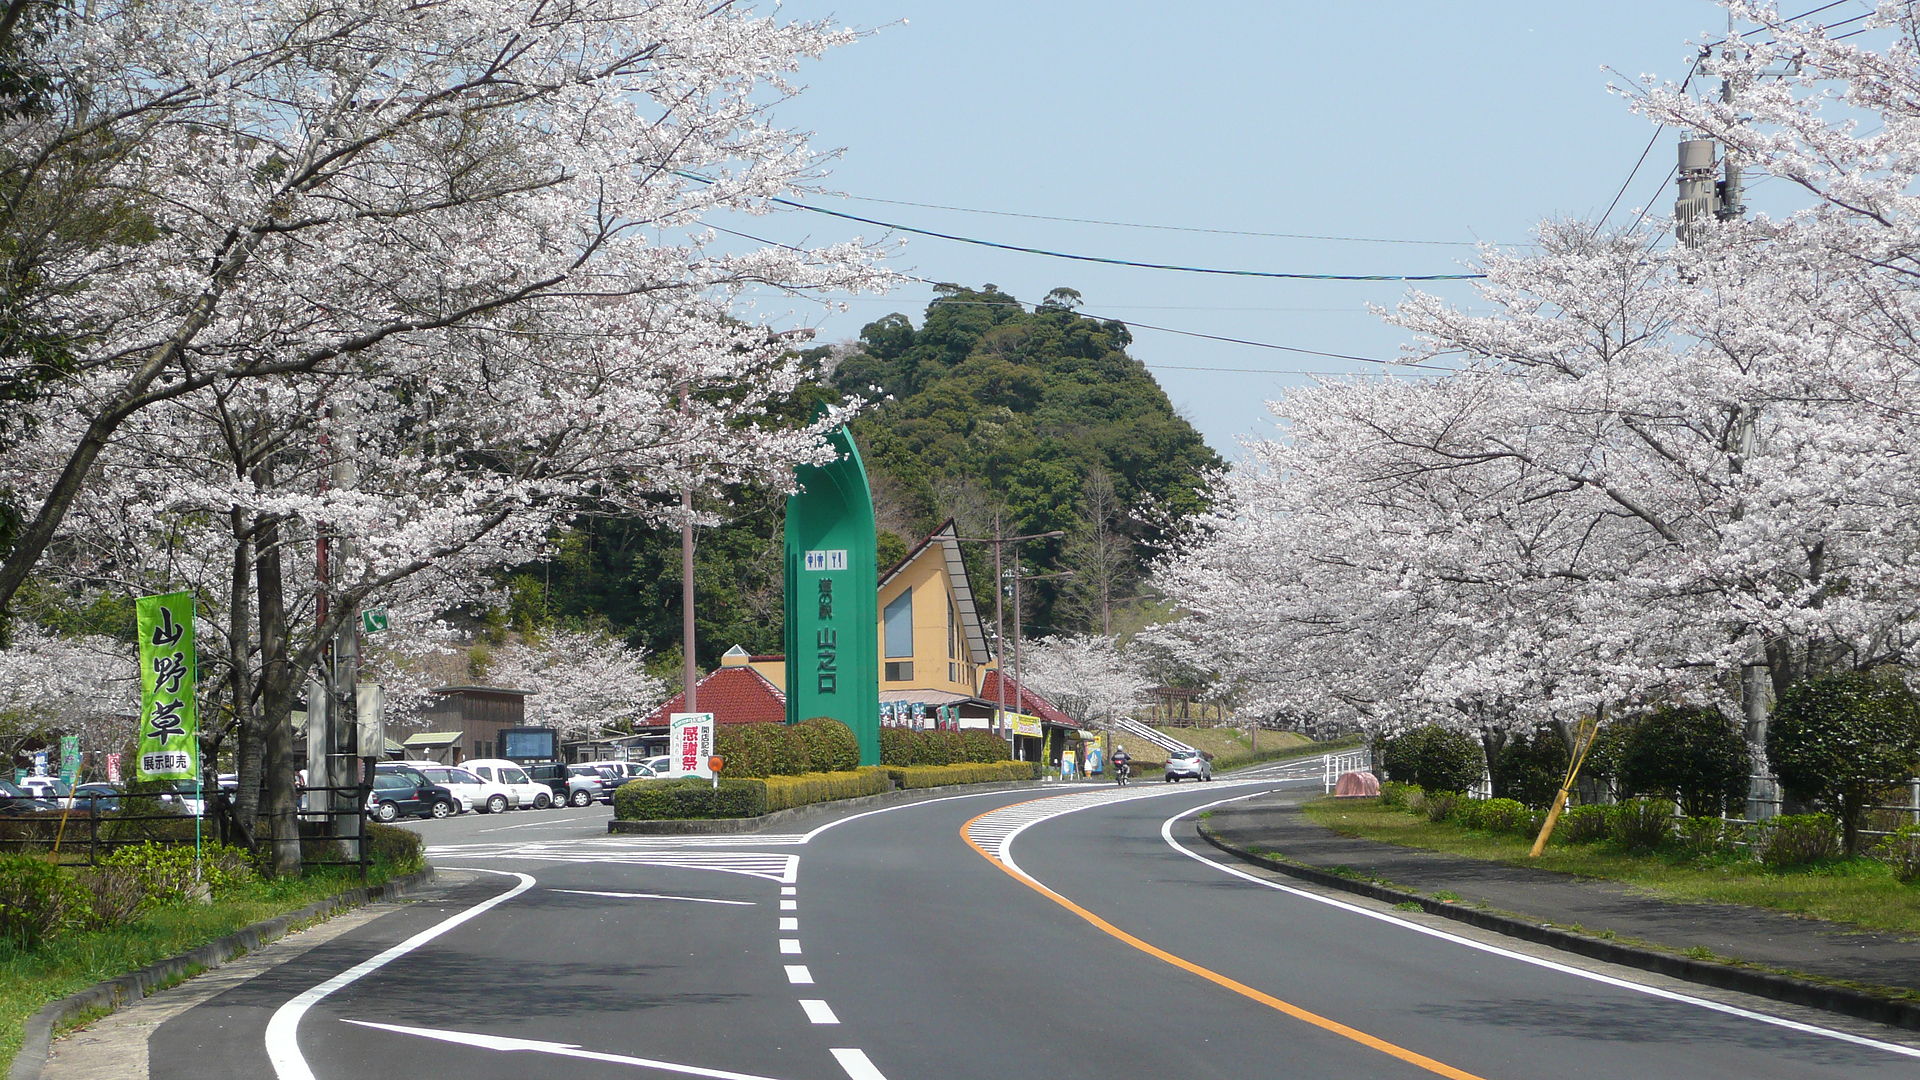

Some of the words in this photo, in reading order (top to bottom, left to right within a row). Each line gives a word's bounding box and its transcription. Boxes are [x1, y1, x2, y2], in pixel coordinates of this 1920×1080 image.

[147, 606, 187, 746] 山野草
[817, 627, 837, 694] 山之口
[143, 754, 187, 770] 展示即売
[682, 725, 698, 771] 感謝祭
